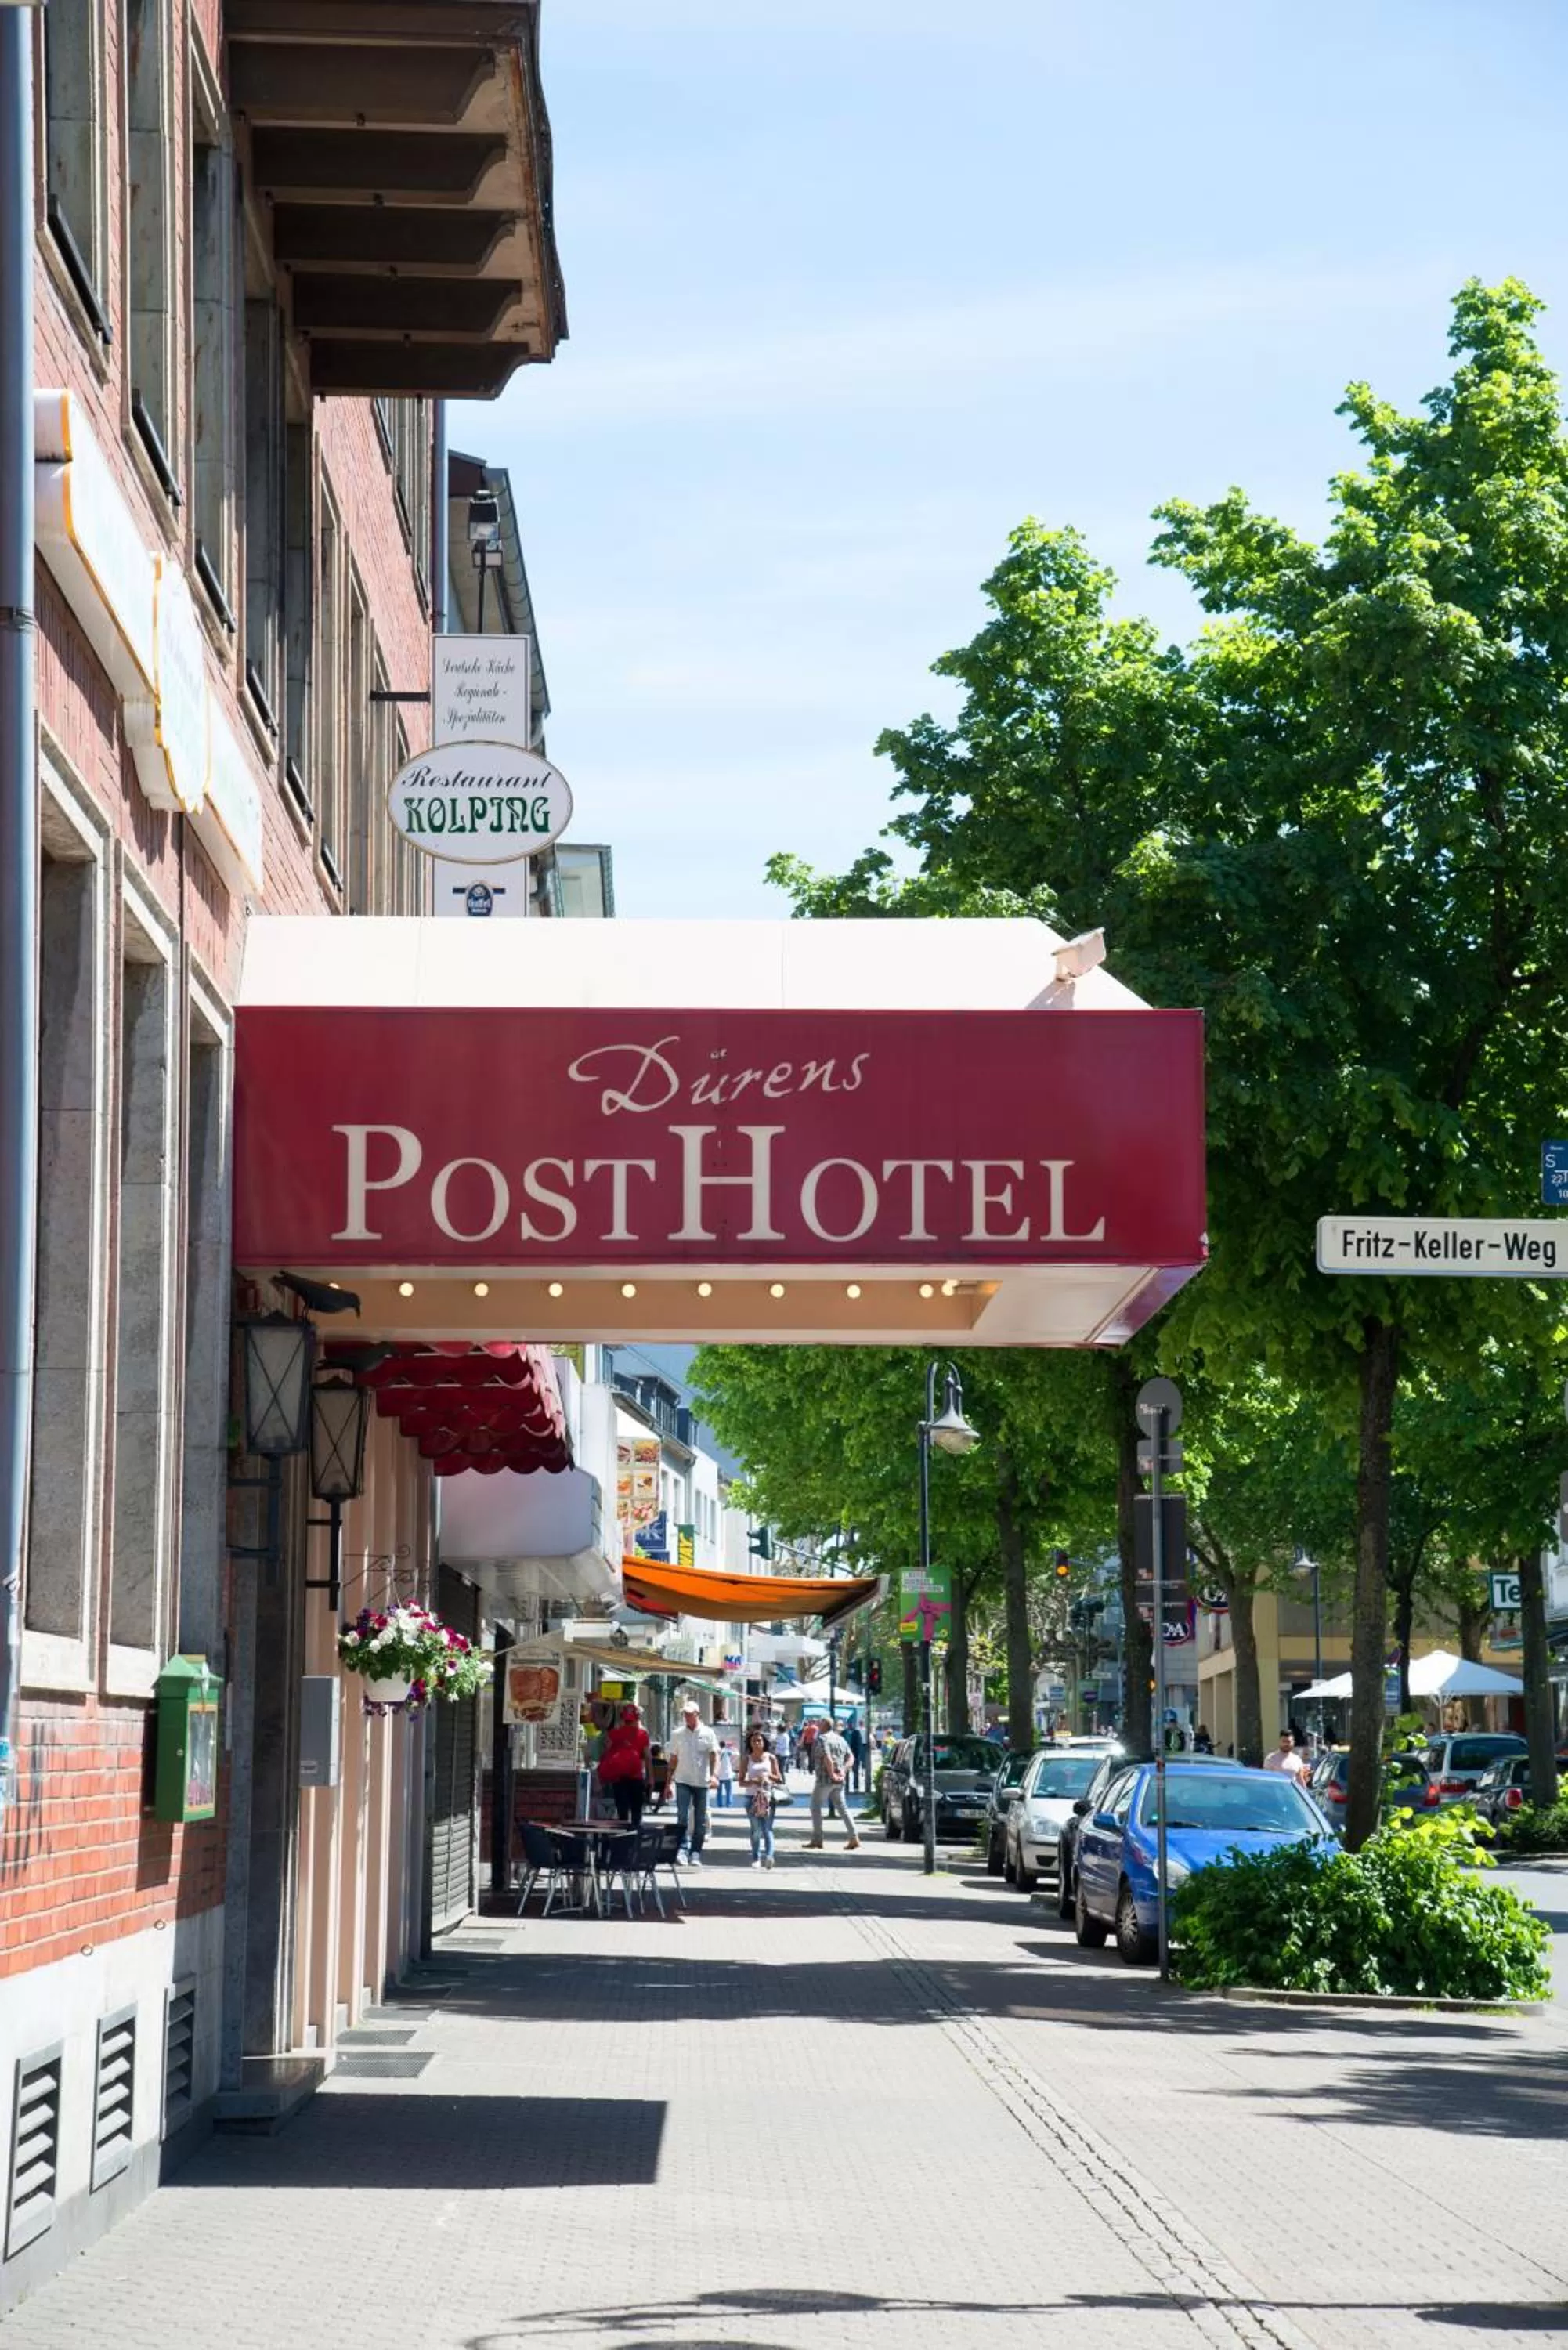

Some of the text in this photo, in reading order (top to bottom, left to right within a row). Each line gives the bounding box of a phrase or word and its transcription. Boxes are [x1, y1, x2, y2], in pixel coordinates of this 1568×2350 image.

[443, 707, 506, 731] Spezialitäten
[402, 765, 551, 787] Restaurant
[403, 796, 551, 833] KOLPING
[568, 1036, 869, 1115] Dürens
[1342, 1229, 1557, 1268] Fritz-Keller-Weg
